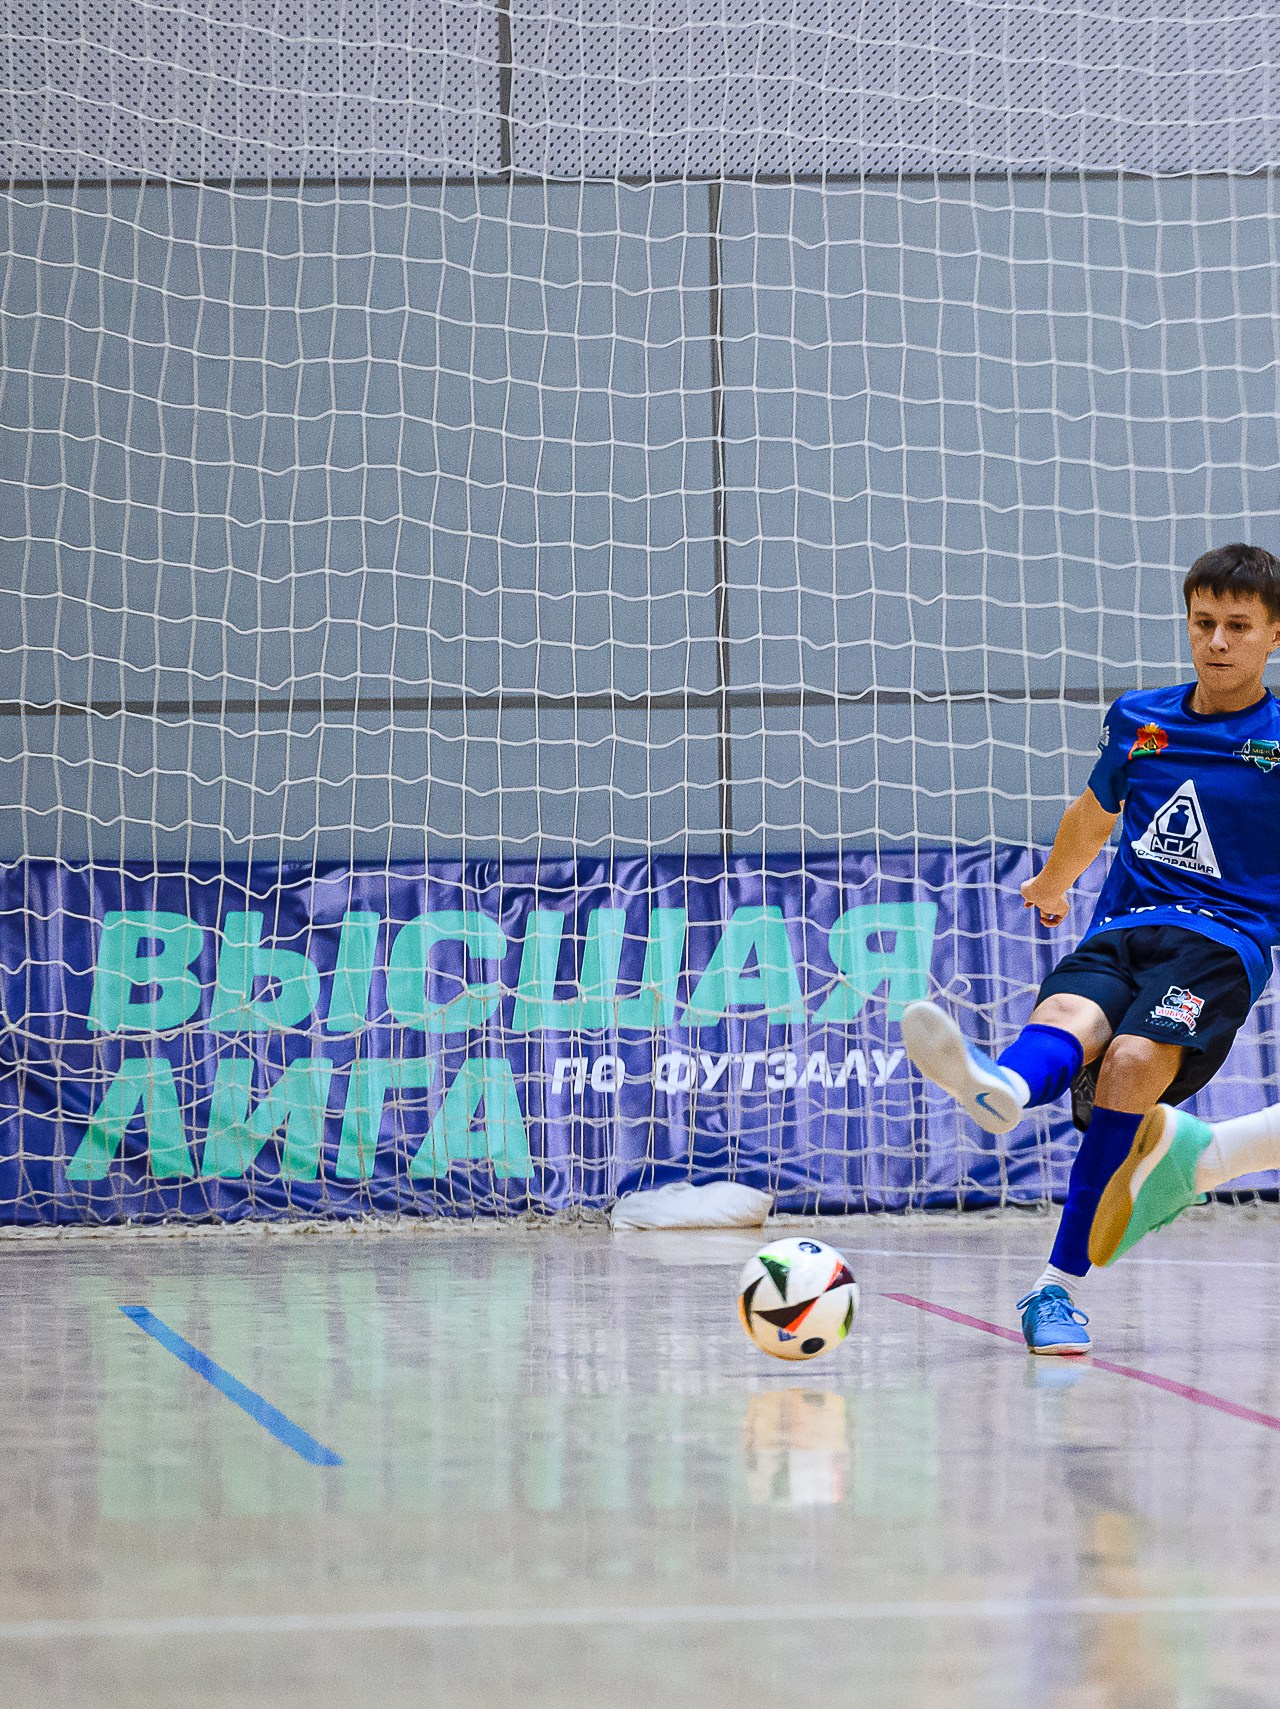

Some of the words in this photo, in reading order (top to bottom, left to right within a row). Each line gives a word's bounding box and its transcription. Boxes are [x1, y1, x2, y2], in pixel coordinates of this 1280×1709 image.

[1151, 836, 1197, 858] АСИ
[87, 902, 938, 1032] ВЫСШАЯ
[551, 1055, 625, 1094] ПО
[654, 1049, 905, 1093] ФУТЗАЛУ
[65, 1058, 534, 1181] ЛИГА
